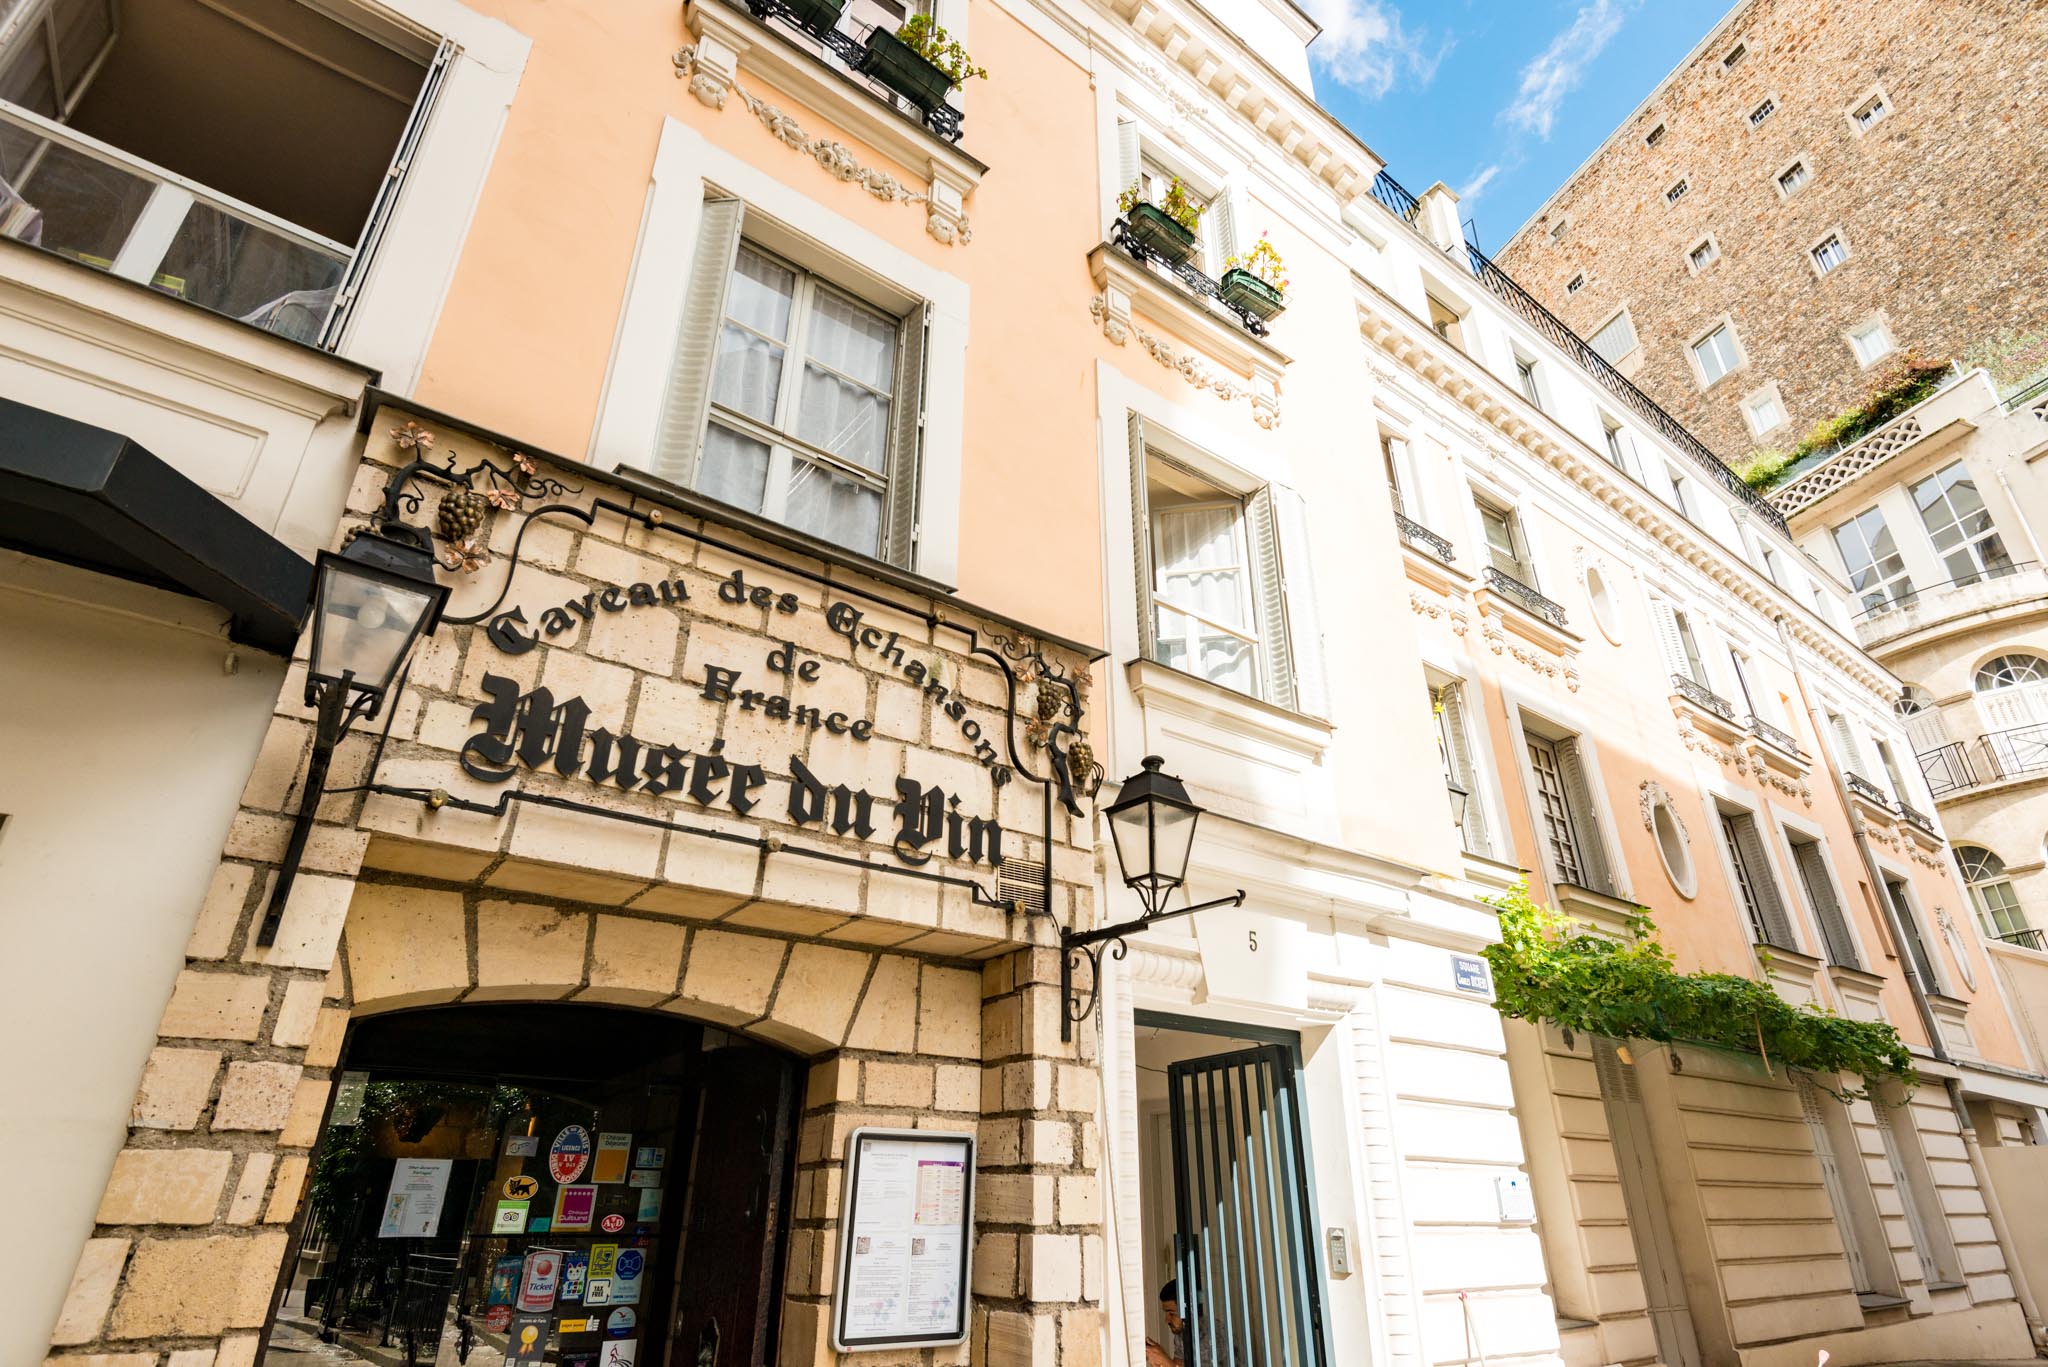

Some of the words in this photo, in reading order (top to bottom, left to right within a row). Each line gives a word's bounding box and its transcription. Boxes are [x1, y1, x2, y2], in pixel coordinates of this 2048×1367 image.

[487, 578, 690, 655] Caveau
[718, 570, 799, 614] des
[827, 601, 1013, 787] Echansons
[767, 643, 821, 682] de
[700, 664, 873, 742] France
[460, 672, 766, 815] Musée
[787, 755, 876, 840] du
[894, 774, 1003, 867] Vin
[1248, 930, 1258, 952] 5
[553, 1128, 570, 1148] VILLE
[579, 1128, 590, 1149] PARIS
[529, 1283, 553, 1291] Ticket
